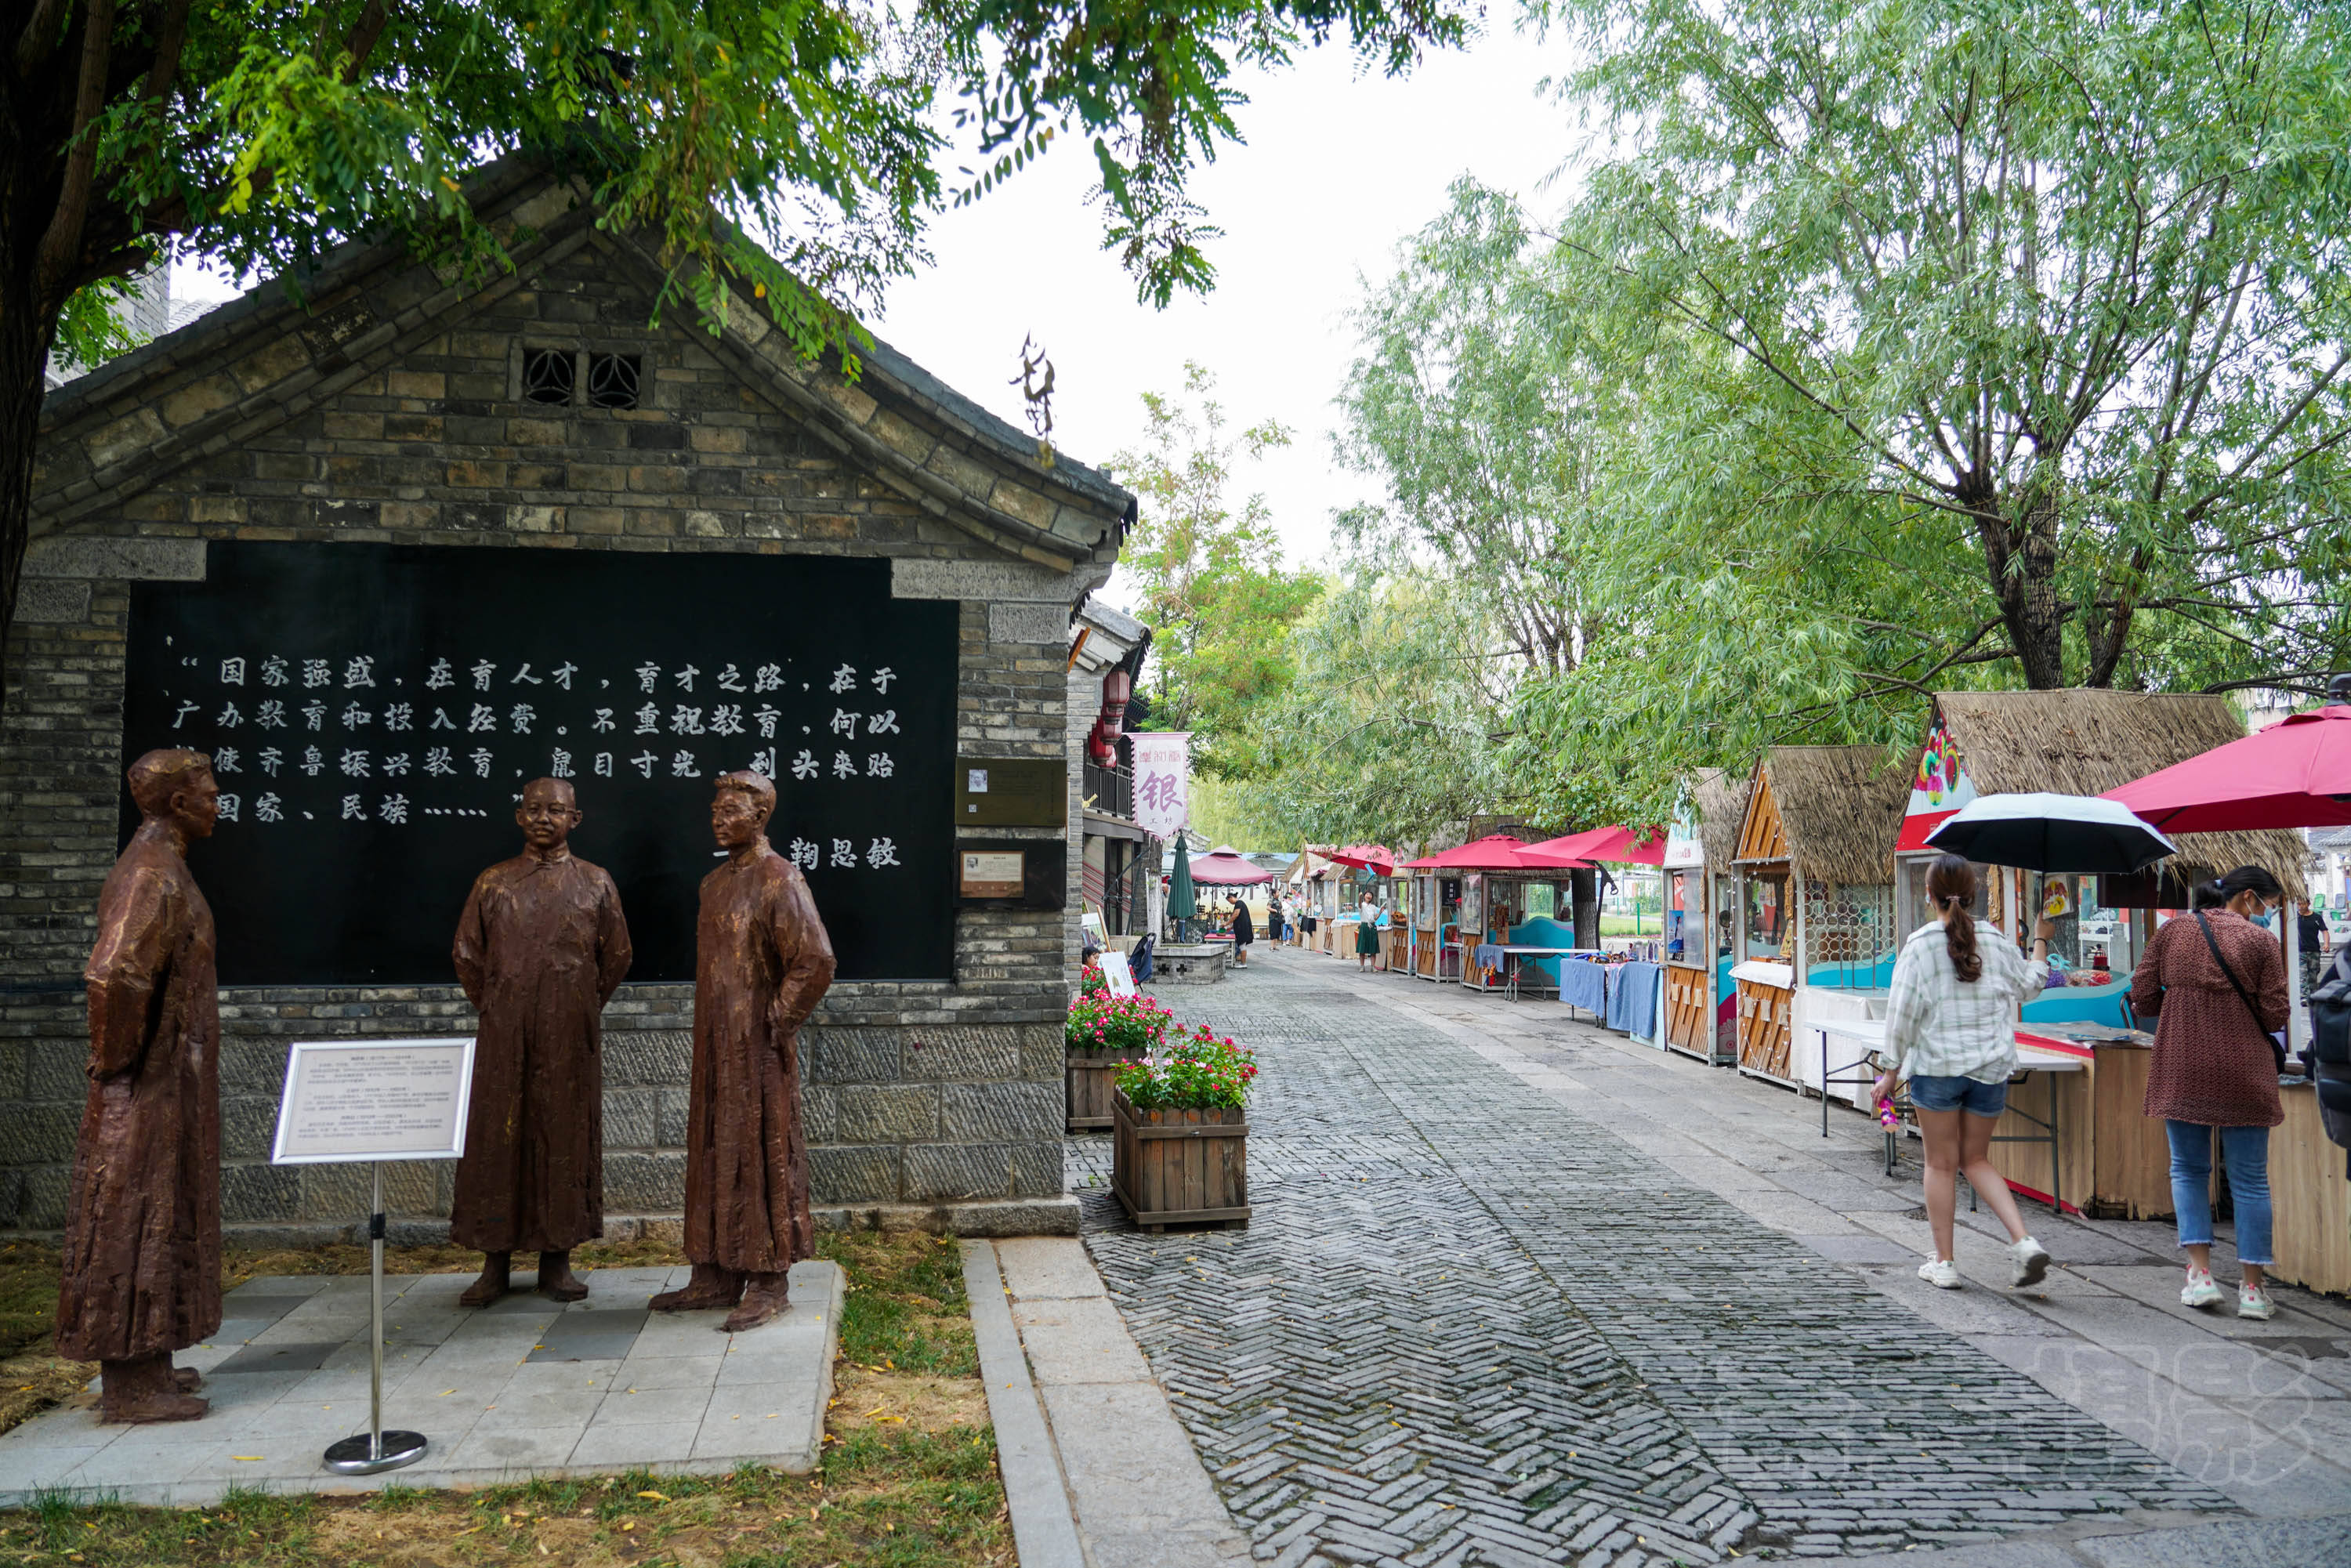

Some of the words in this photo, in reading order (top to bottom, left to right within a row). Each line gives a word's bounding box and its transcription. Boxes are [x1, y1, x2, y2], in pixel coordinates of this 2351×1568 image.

[176, 744, 895, 780] 使齐鲁振兴教育，鼠目寸光，到头来贻
[1139, 770, 1183, 813] 银
[1150, 817, 1173, 827] 工坊
